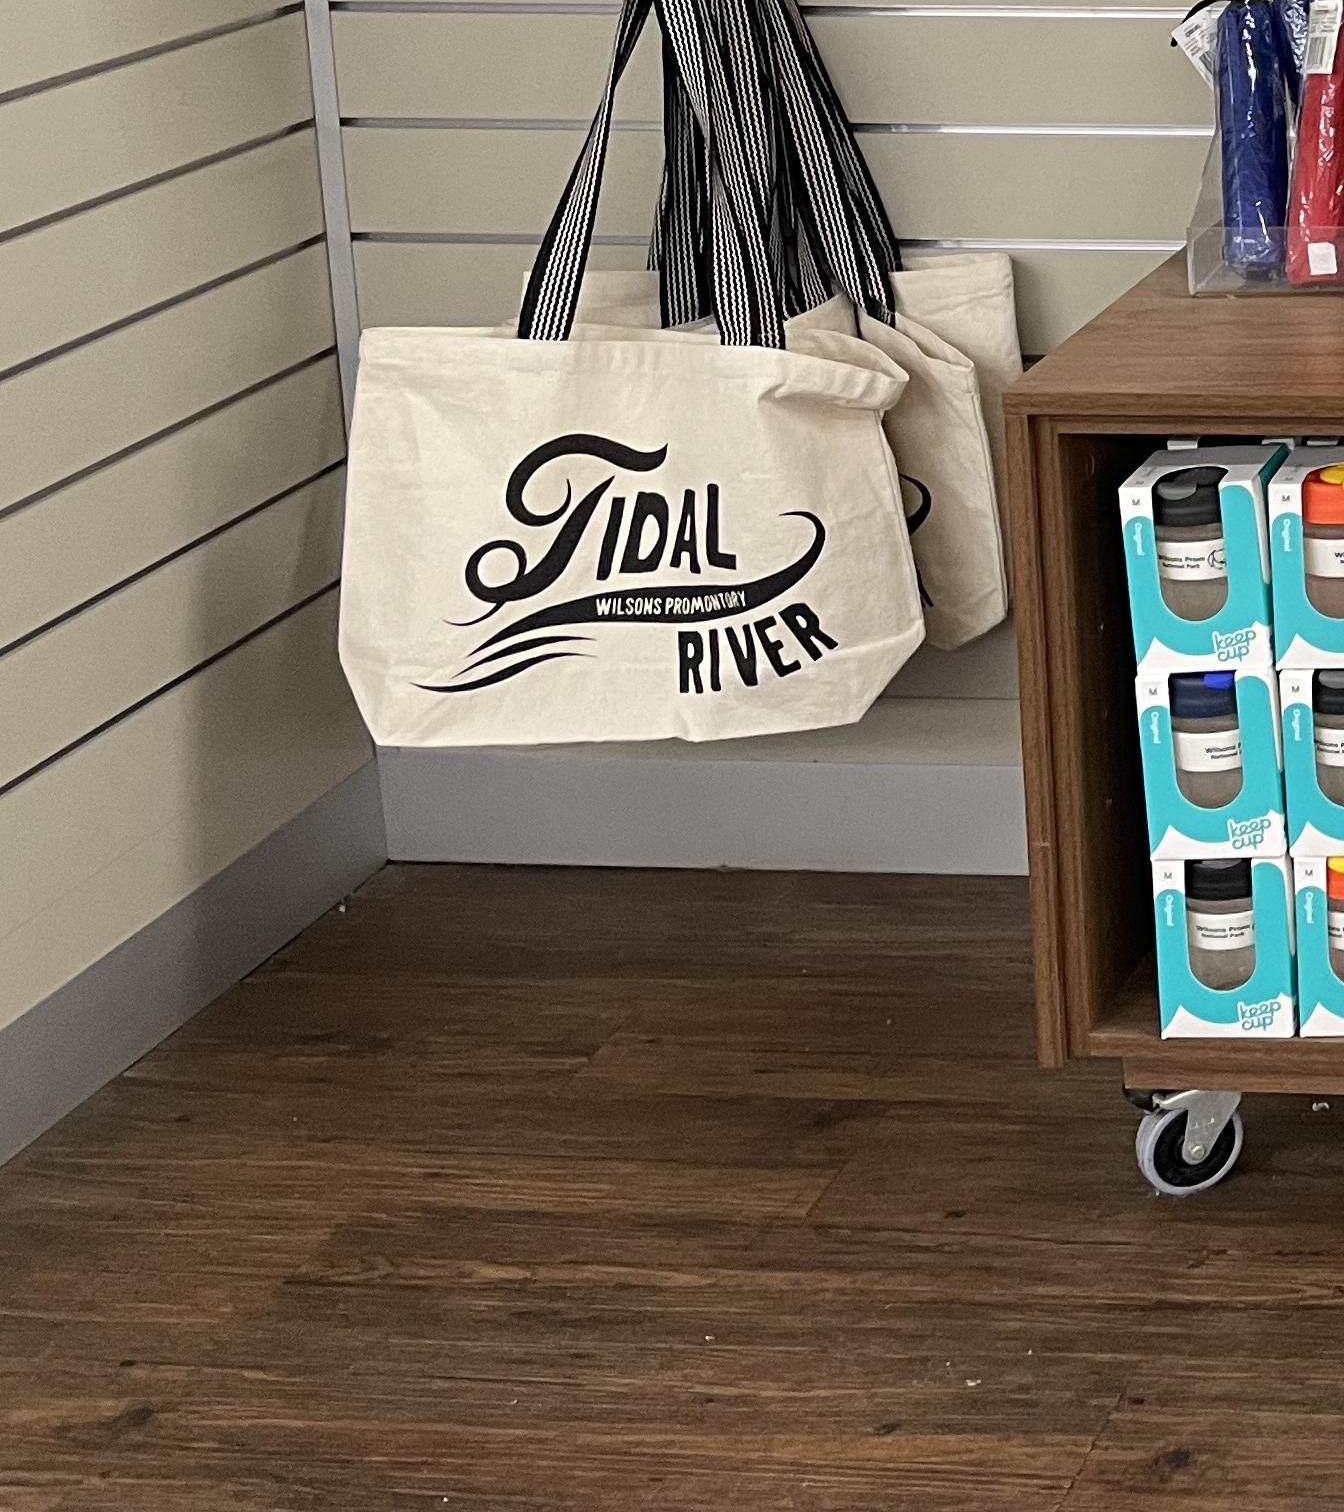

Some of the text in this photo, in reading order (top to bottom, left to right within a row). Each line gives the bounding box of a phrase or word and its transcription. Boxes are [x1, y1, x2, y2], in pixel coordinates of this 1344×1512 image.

[455, 434, 737, 613] TIDAL
[596, 590, 747, 617] WILSONS PROMONTORY
[677, 603, 839, 694] RIVER
[1214, 630, 1256, 650] keep
[1218, 645, 1249, 661] cup
[1228, 819, 1271, 837] keep
[1232, 834, 1264, 850] cup
[1238, 1001, 1281, 1020] keep
[1242, 1015, 1273, 1032] cup
